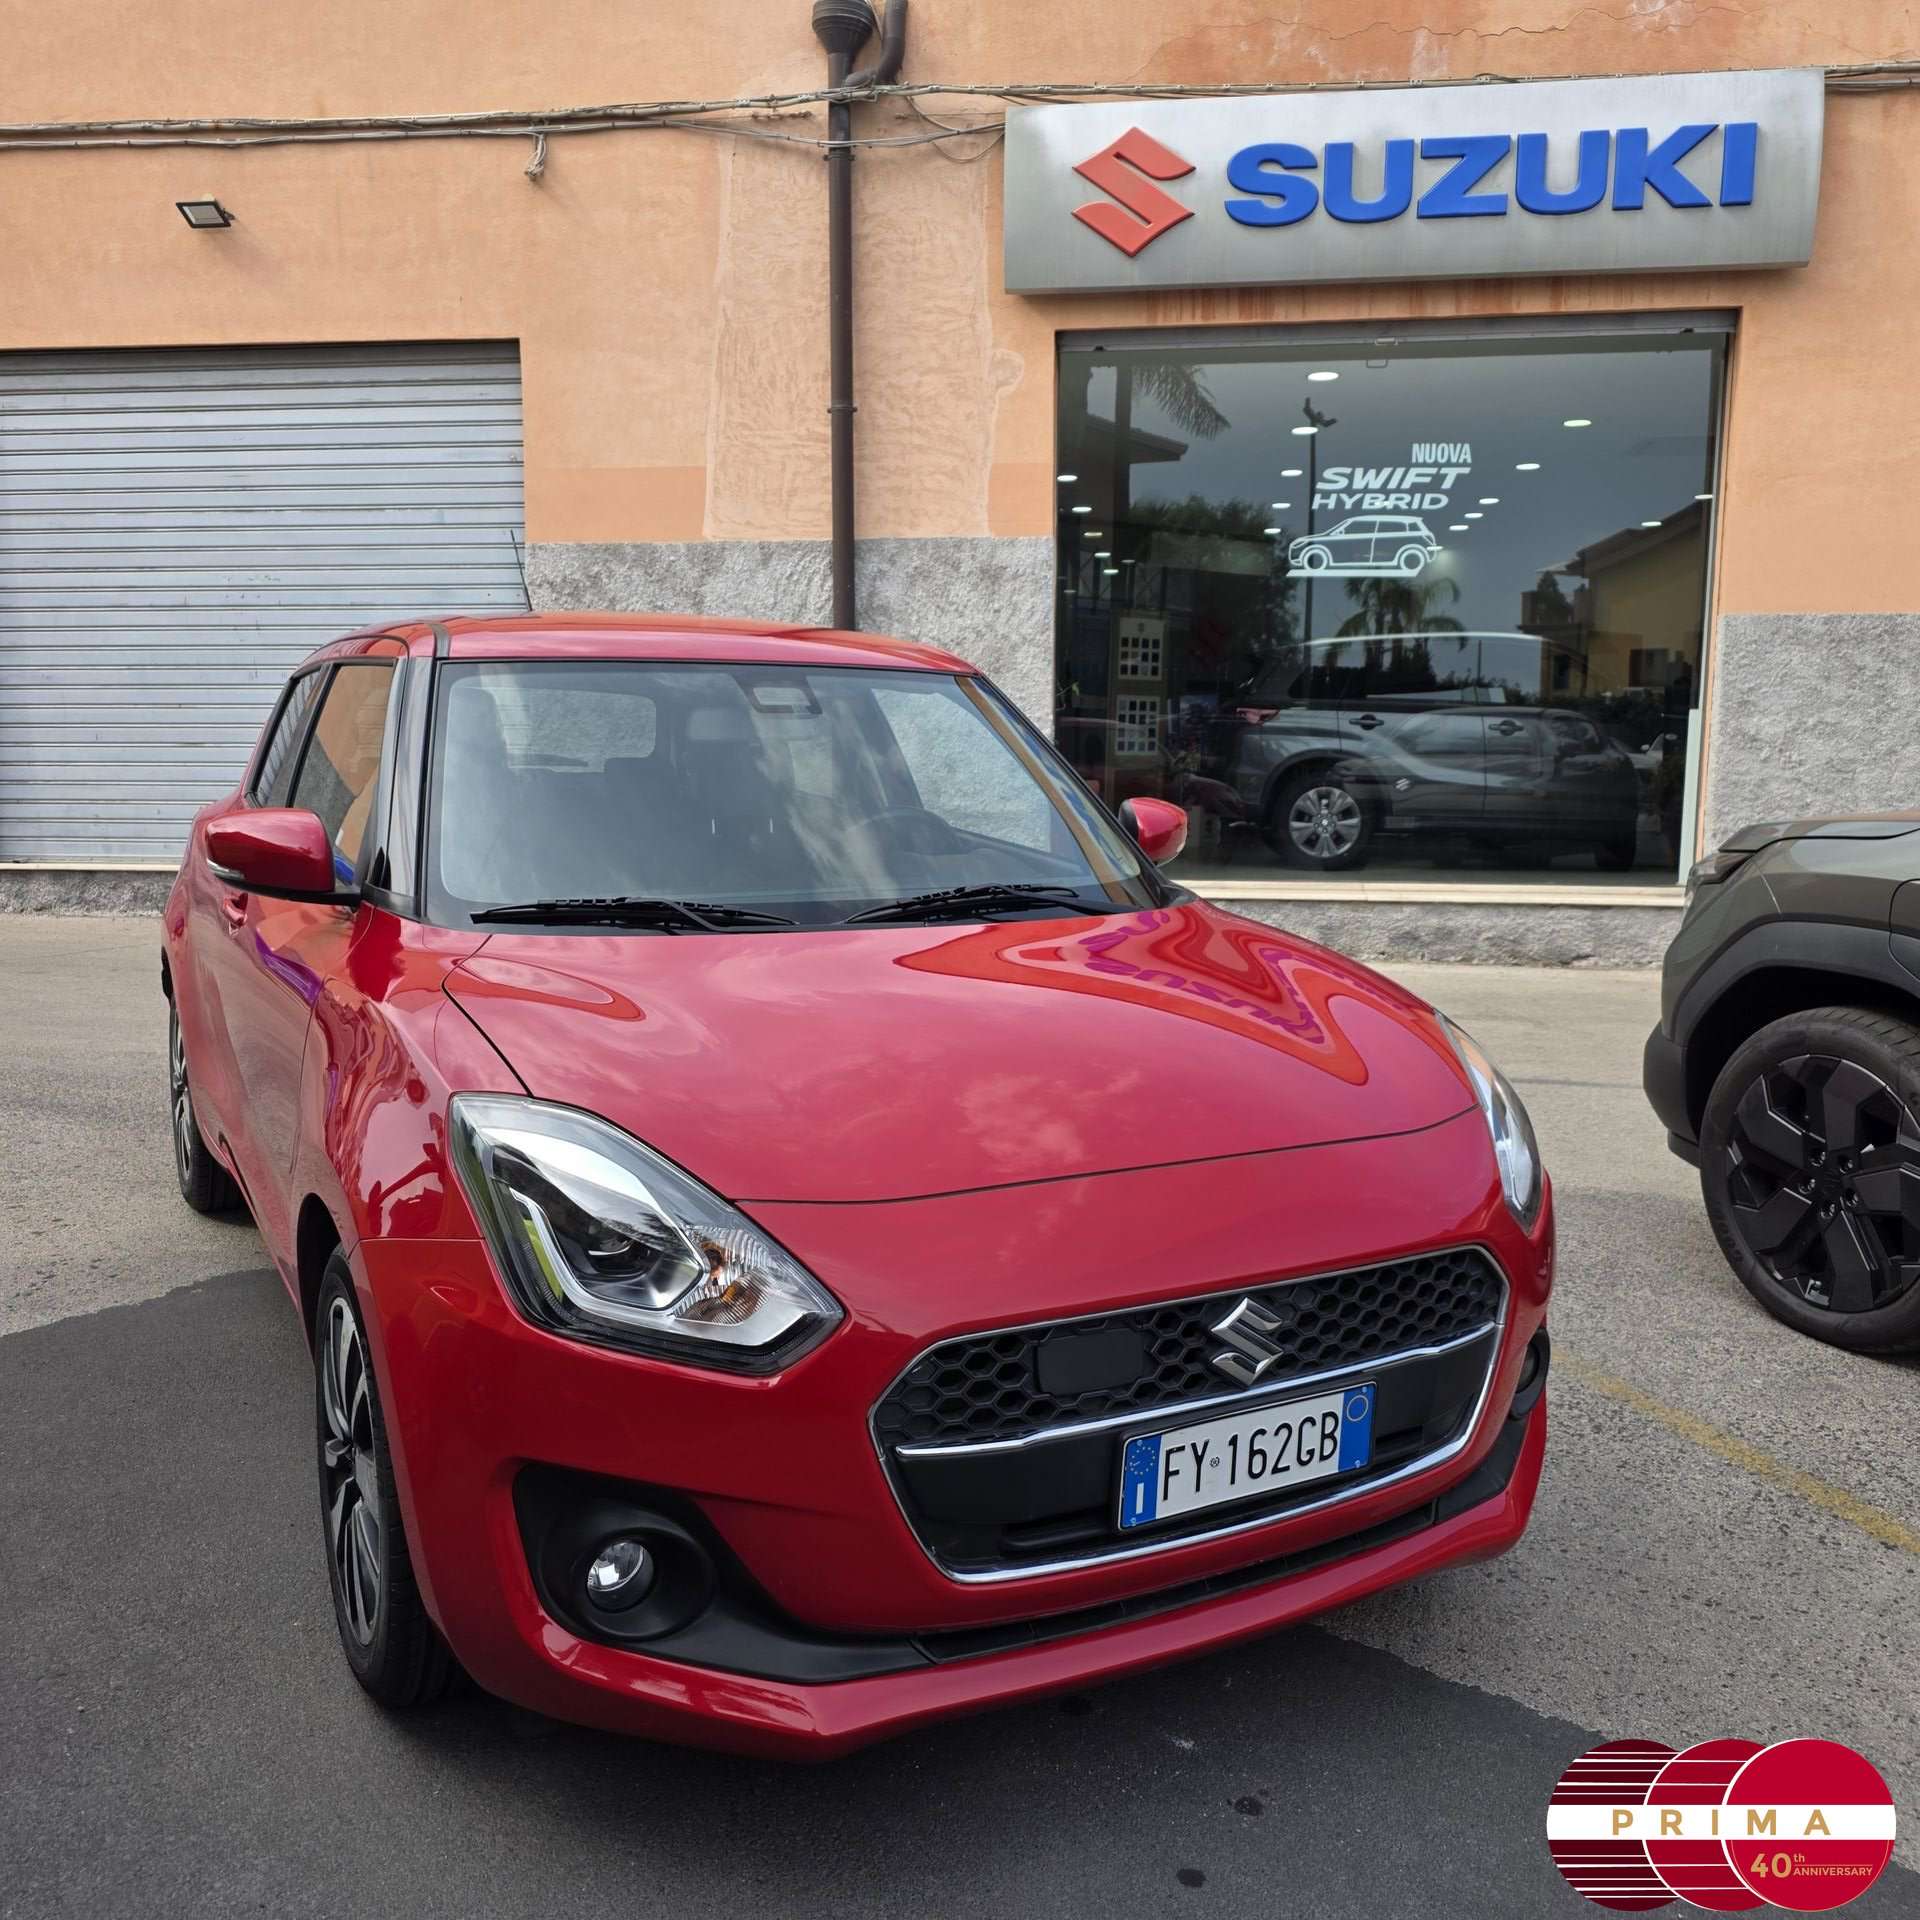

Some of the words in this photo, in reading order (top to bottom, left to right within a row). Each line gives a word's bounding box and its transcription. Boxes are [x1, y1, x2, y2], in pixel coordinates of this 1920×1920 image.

[1224, 122, 1758, 228] SUZUKI
[1411, 443, 1472, 463] NUOVA
[1315, 467, 1471, 489] SWIFT
[1311, 493, 1449, 510] HYBRID
